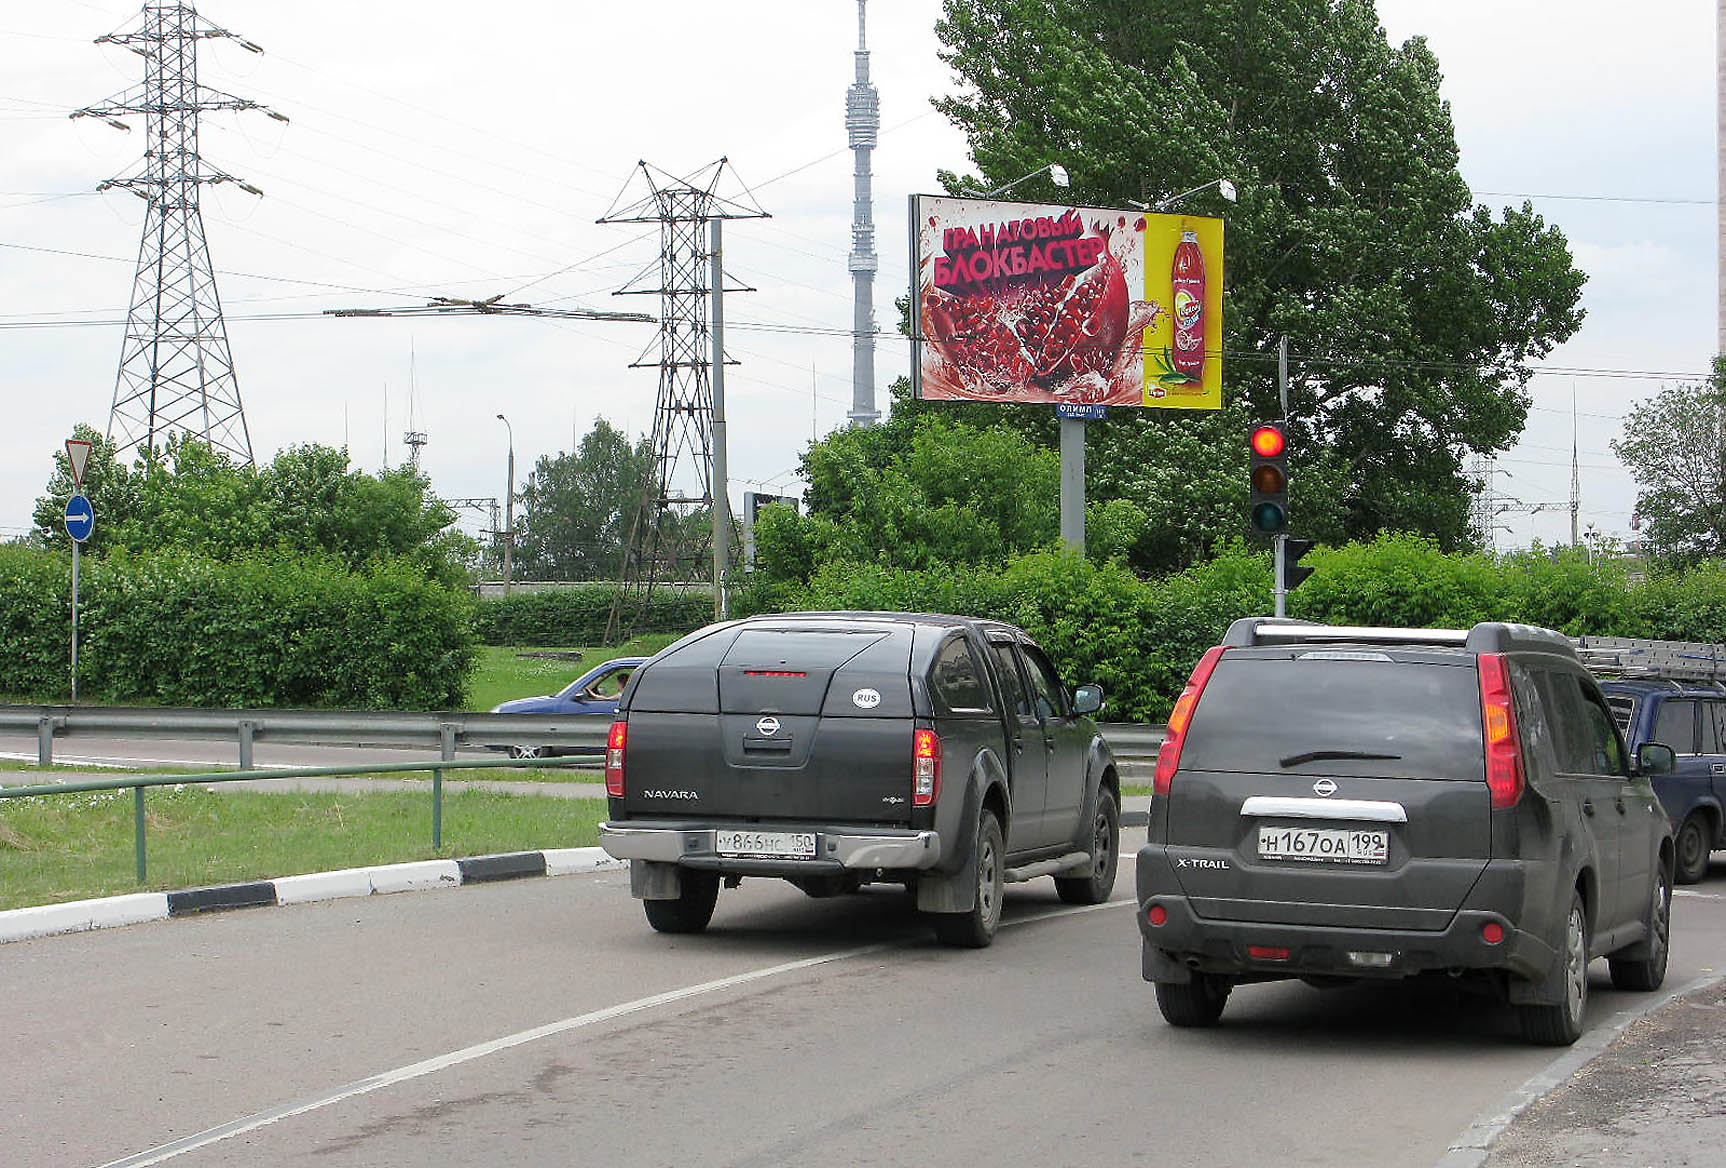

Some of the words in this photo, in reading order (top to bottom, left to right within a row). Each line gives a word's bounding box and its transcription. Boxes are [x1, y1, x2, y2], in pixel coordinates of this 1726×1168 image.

[943, 208, 1084, 251] ГРАНАТОВЫЙ
[934, 237, 1105, 287] БЛОКБАСТЕР
[1059, 404, 1092, 413] ОЛИМП
[857, 694, 877, 702] RUS
[644, 790, 699, 799] NAVARA
[1351, 834, 1382, 850] 199
[1177, 858, 1230, 869] X-TRAIL
